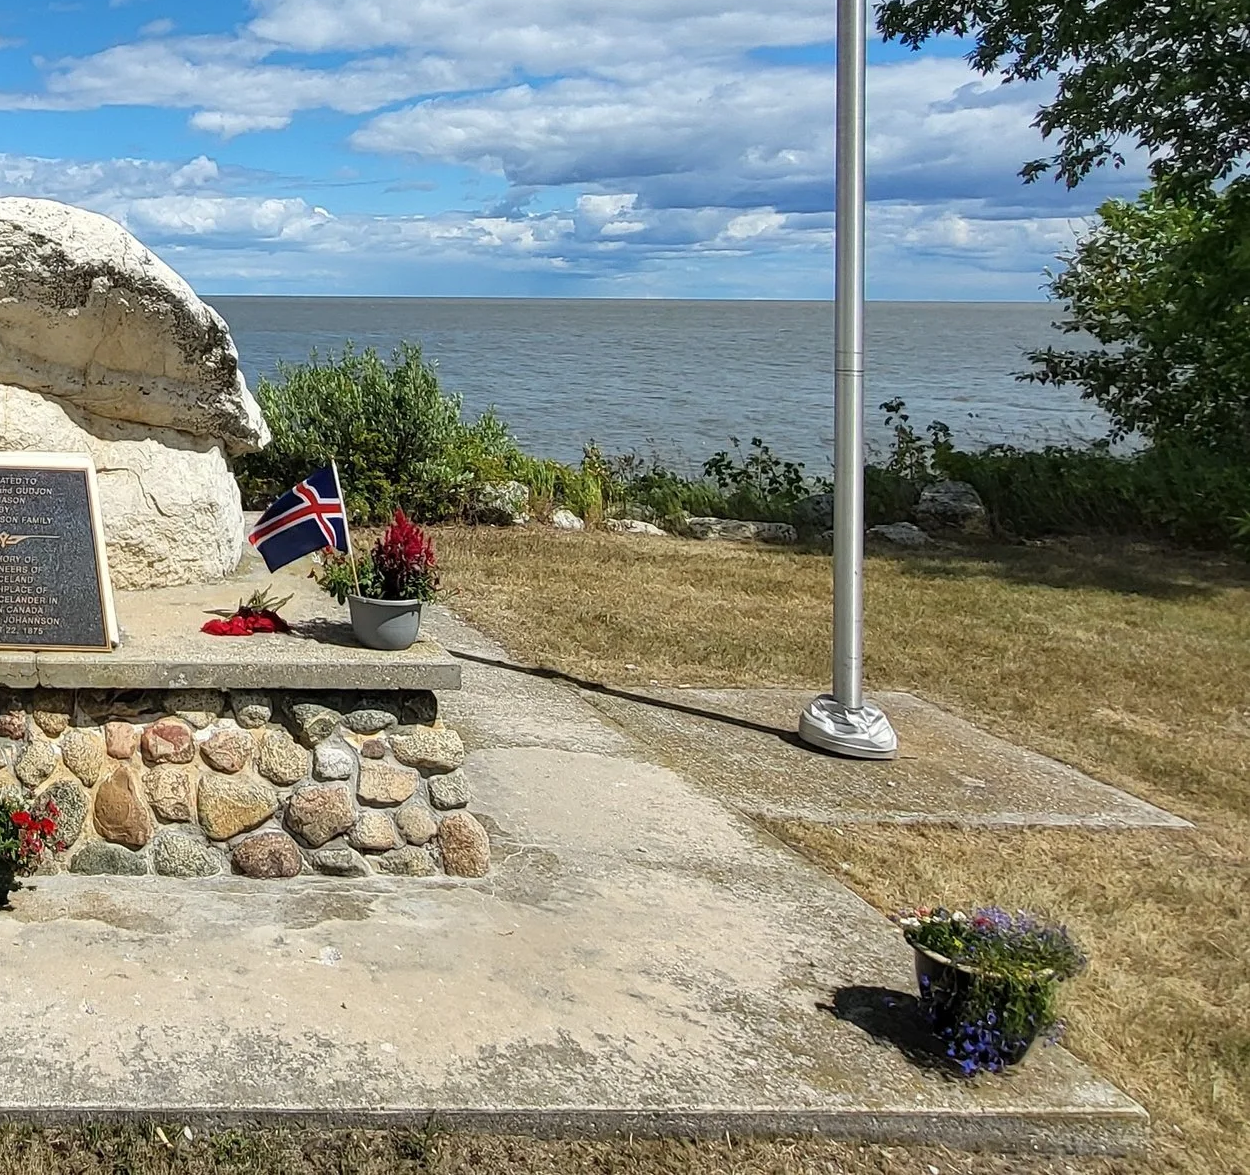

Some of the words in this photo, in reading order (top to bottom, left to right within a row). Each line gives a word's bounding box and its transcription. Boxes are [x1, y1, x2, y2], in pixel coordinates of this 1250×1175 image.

[22, 517, 53, 525] FAMILY
[31, 566, 43, 574] OF
[7, 606, 44, 614] CANADA
[23, 627, 44, 635] 1875
